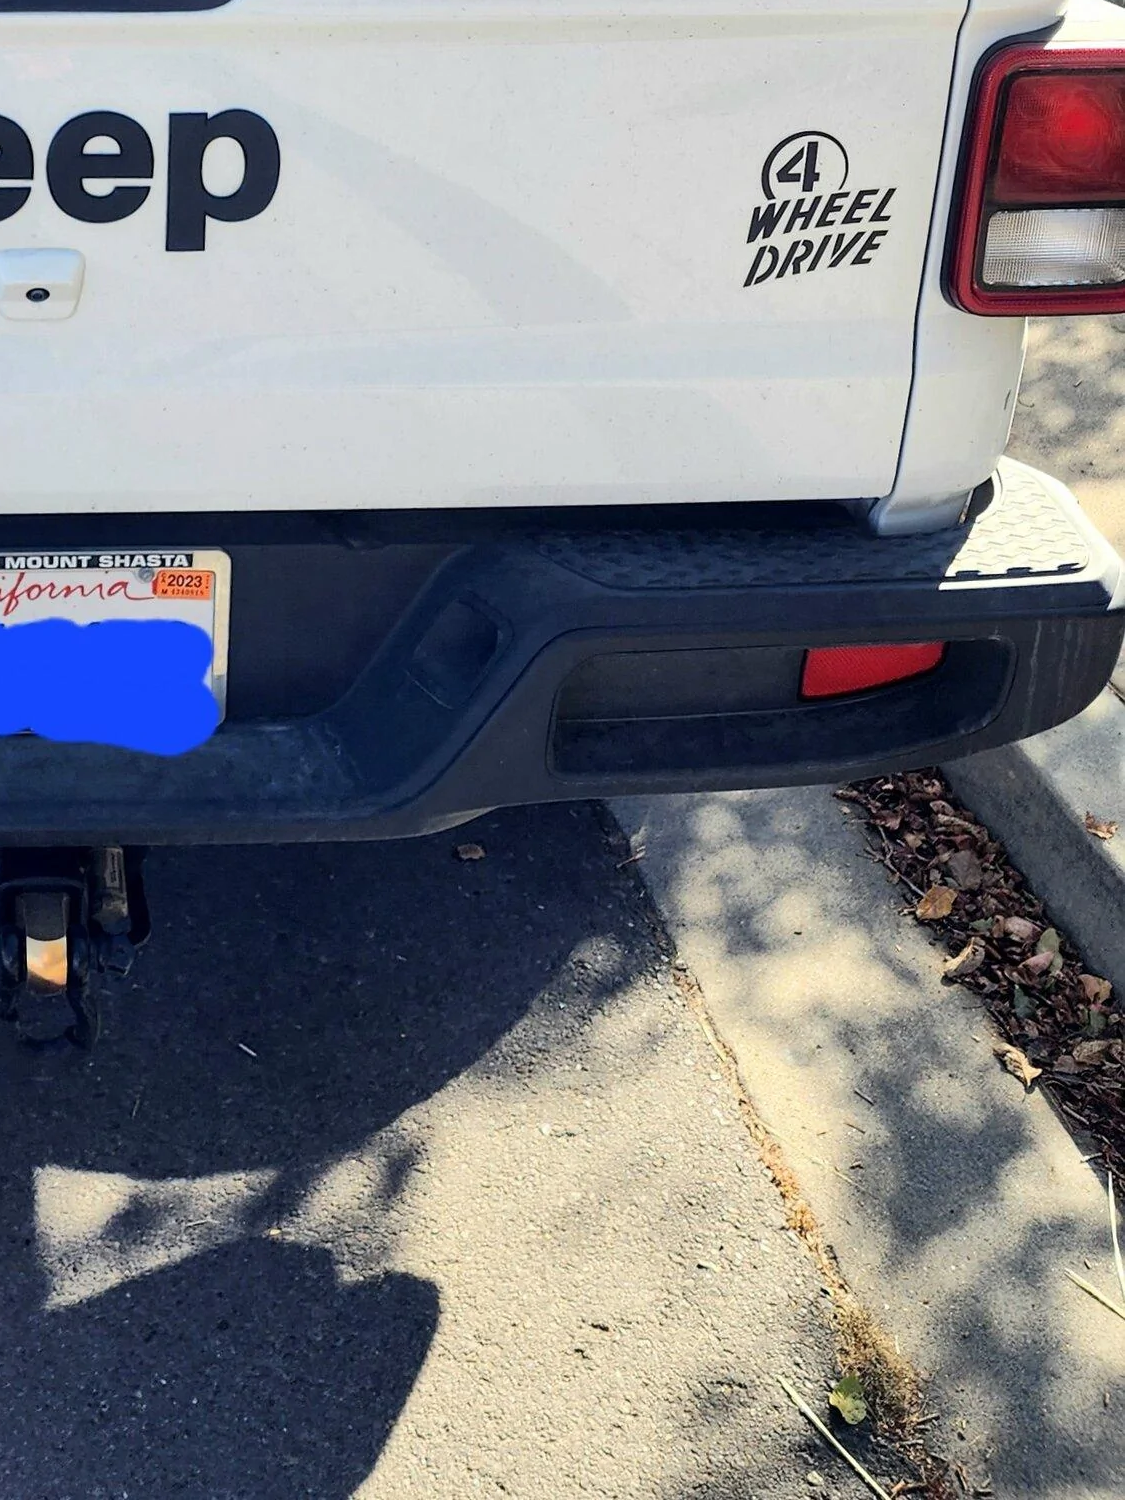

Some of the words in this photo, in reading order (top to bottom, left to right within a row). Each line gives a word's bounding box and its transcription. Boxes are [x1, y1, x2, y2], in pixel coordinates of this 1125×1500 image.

[776, 141, 820, 192] 4
[746, 187, 898, 244] WHEEL
[742, 229, 889, 288] DRIVE
[4, 556, 92, 570] MOUNT
[98, 554, 189, 568] SHASTA
[167, 574, 203, 588] 2023
